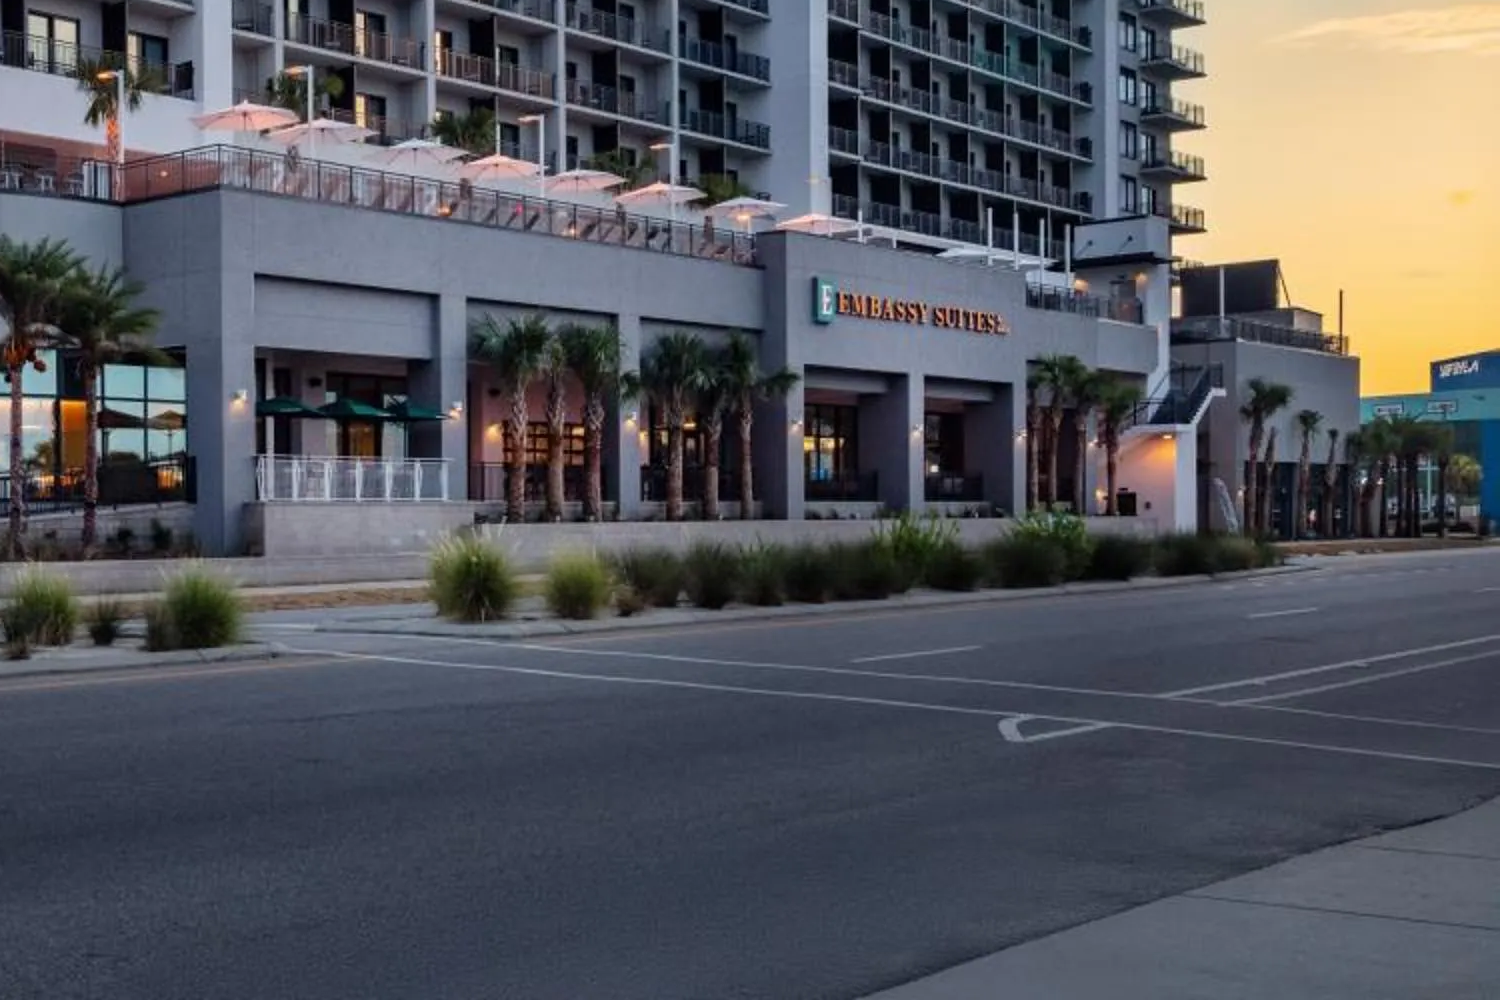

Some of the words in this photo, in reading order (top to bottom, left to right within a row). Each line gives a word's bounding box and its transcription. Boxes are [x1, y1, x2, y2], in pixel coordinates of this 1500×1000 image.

[821, 284, 833, 316] E
[837, 290, 928, 324] EMBASSY
[932, 306, 995, 333] SUITES
